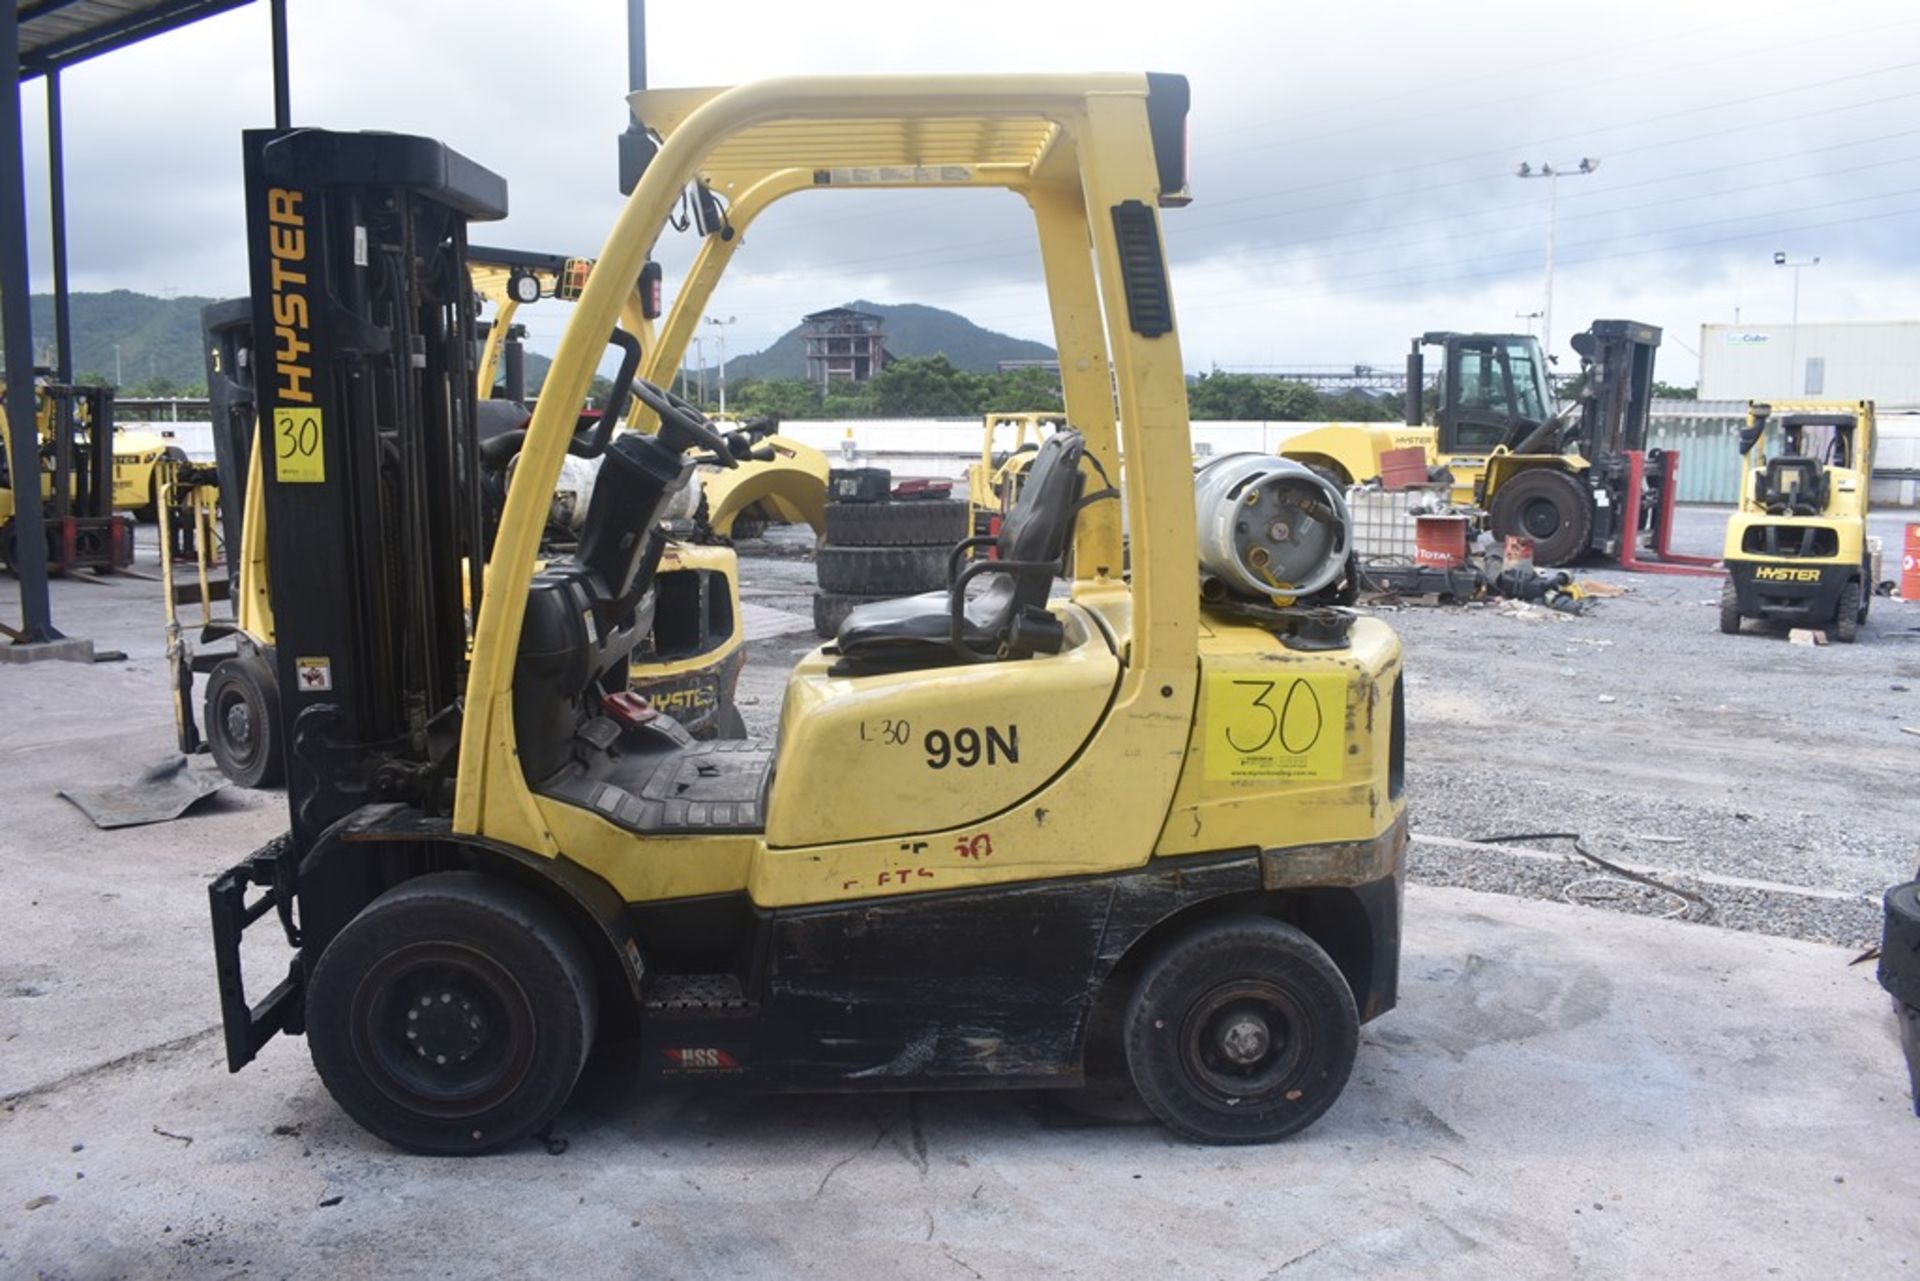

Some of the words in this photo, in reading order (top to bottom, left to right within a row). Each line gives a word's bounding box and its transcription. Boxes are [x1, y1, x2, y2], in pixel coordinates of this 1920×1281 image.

[268, 187, 313, 402] HYSTER
[279, 417, 319, 459] 30
[1395, 436, 1432, 445] HYSTER
[1756, 567, 1821, 582] HYSTER
[1225, 678, 1322, 754] 30
[924, 724, 1018, 769] 99N
[681, 1047, 719, 1067] HSS
